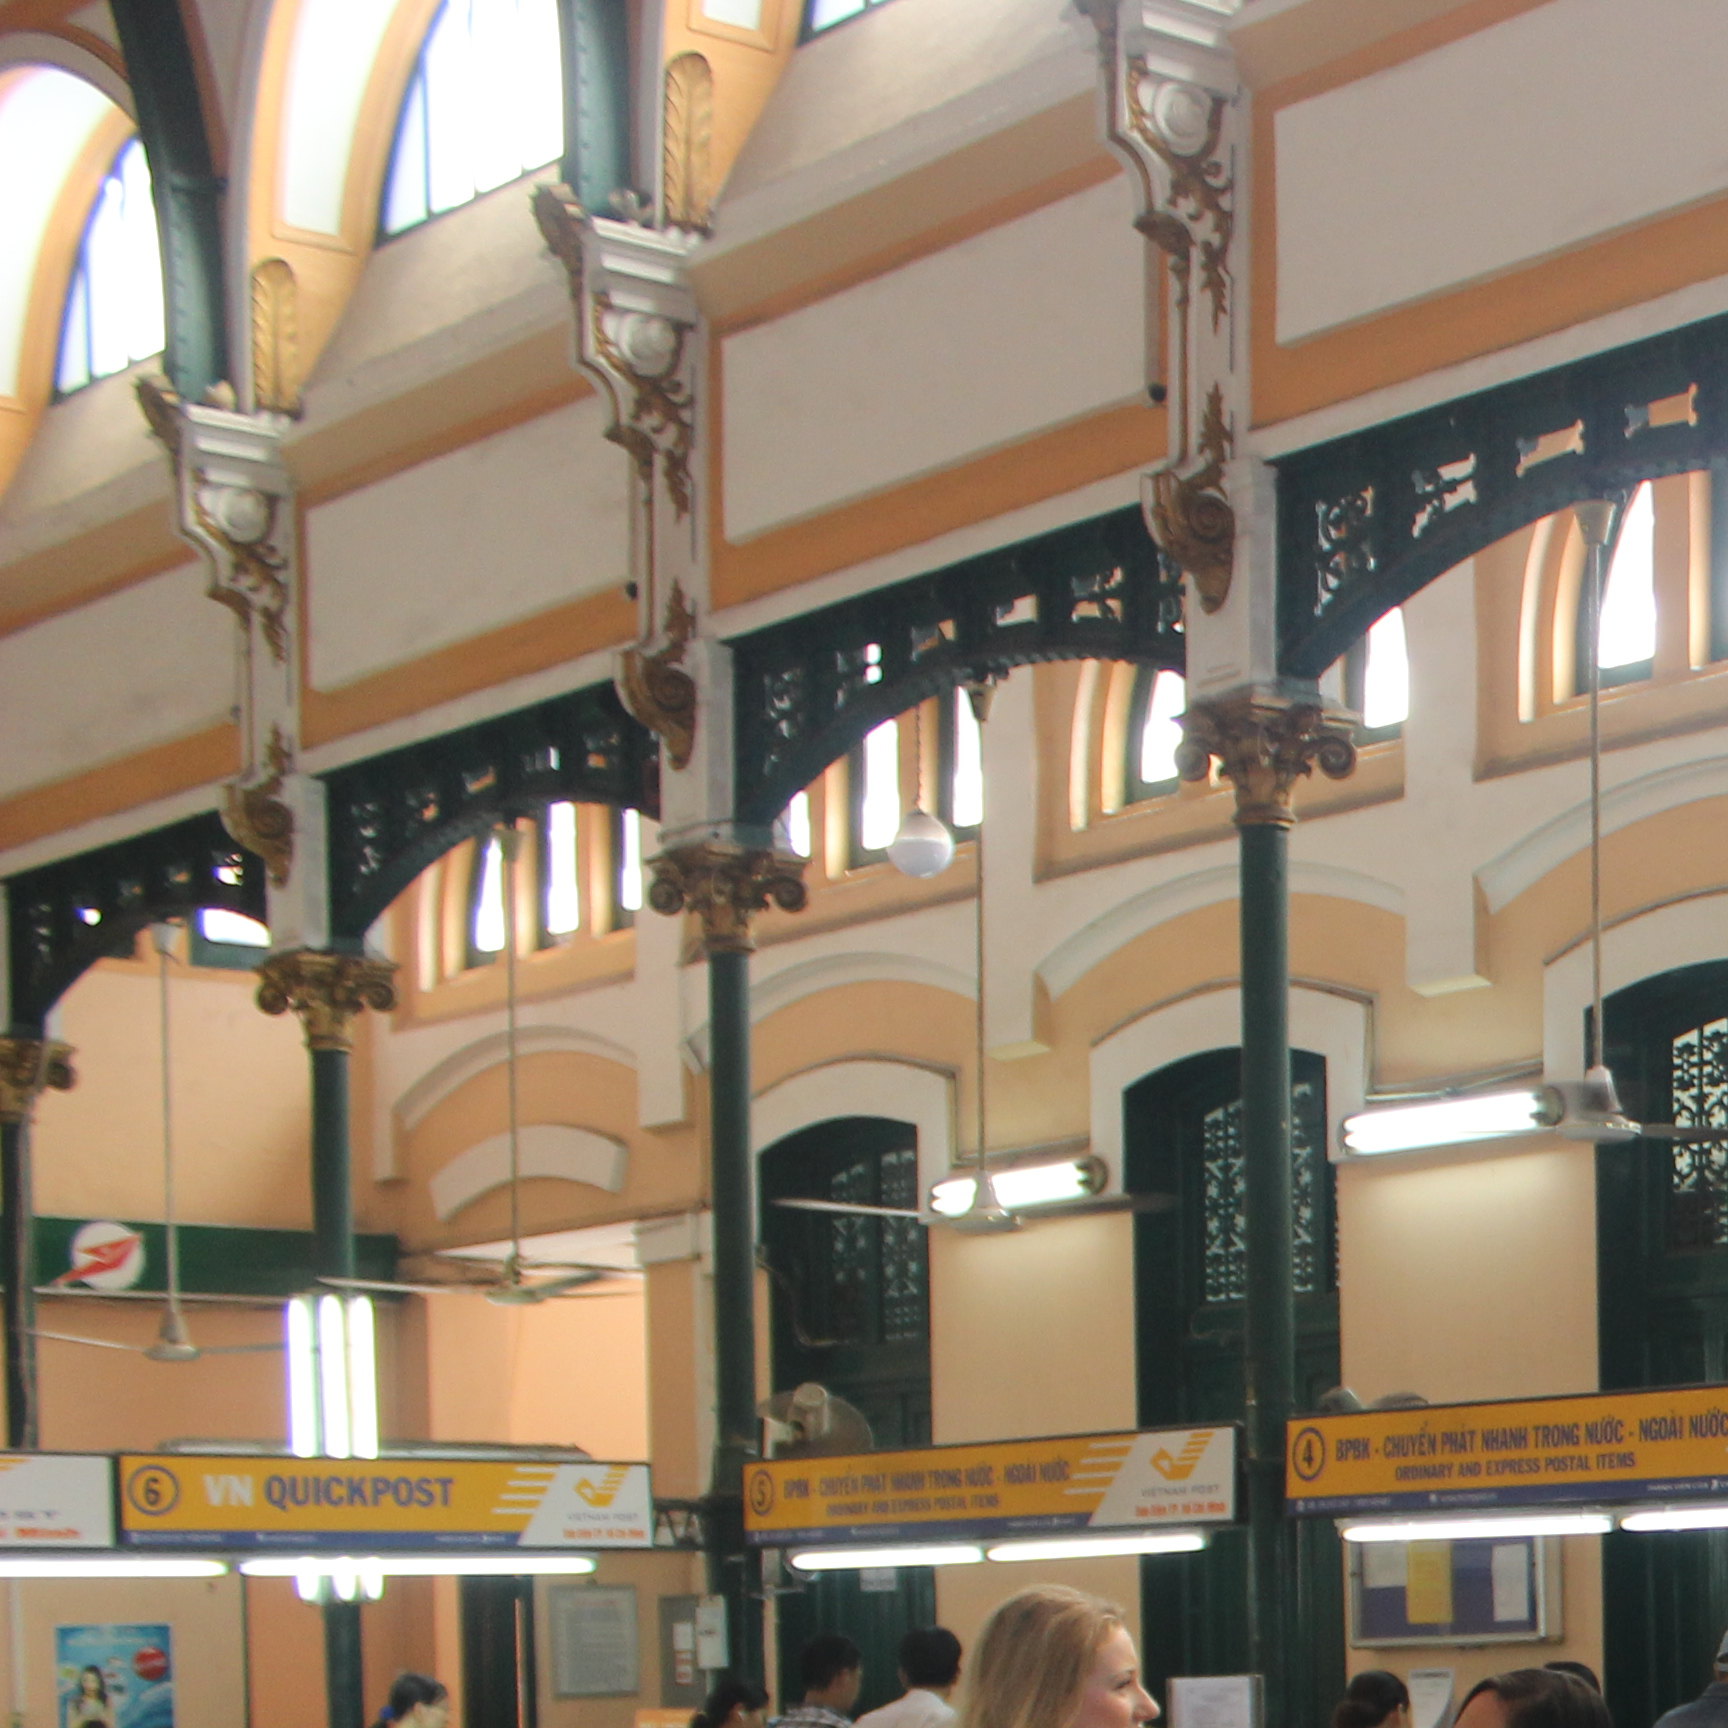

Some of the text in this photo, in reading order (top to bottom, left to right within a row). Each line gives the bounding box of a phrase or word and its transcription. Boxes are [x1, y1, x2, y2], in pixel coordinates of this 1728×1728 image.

[1481, 1426, 1528, 1451] NHANH
[1533, 1422, 1580, 1447] TRONG
[1486, 1458, 1540, 1476] EXPRESS
[1544, 1454, 1591, 1472] POSTAL
[1596, 1452, 1636, 1470] ITEMS
[145, 1477, 161, 1506] 6
[203, 1474, 454, 1511] VN QUICKPOST
